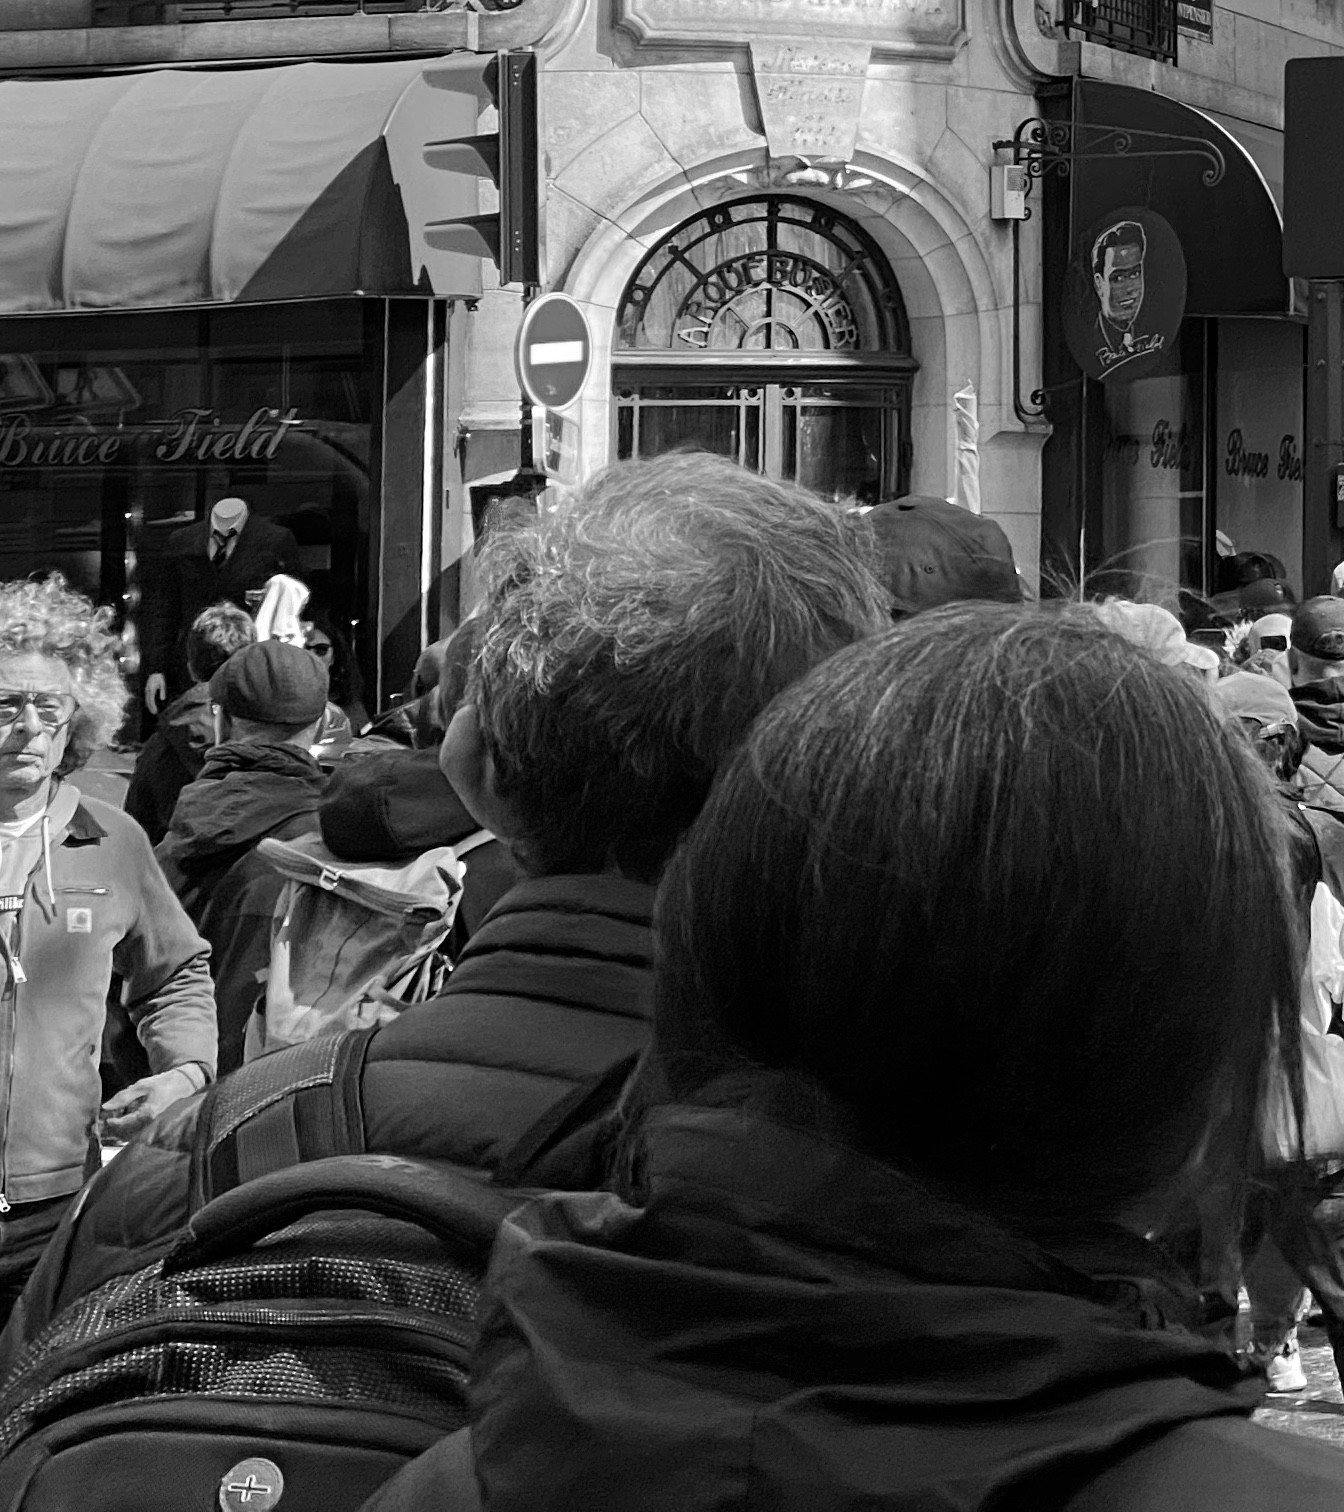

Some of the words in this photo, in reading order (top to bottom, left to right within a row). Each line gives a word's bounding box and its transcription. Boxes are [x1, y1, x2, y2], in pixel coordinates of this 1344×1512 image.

[677, 256, 860, 348] ARQUEBUSIER
[156, 407, 299, 462] Field
[1226, 428, 1268, 478] Bruce
